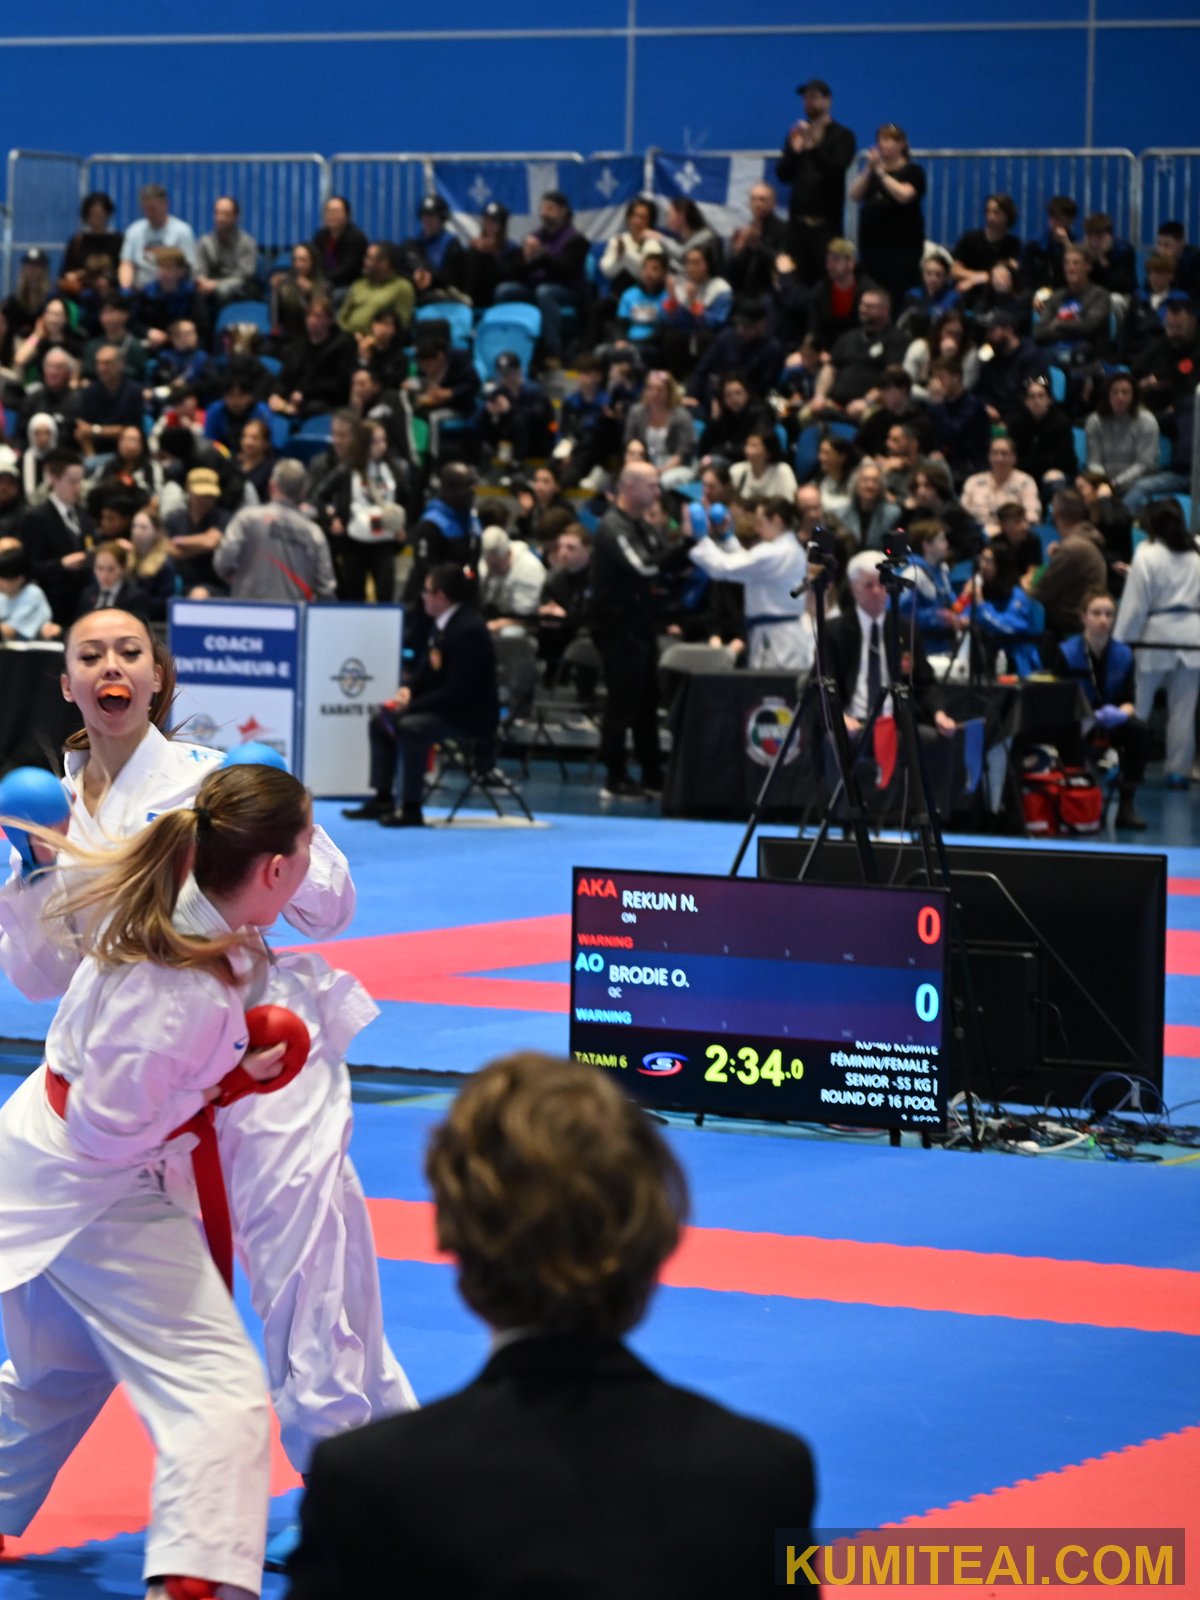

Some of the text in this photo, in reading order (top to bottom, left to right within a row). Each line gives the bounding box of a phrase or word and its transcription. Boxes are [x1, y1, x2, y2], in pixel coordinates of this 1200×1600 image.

[203, 634, 264, 653] COACH
[577, 878, 618, 898] AKA
[622, 890, 699, 913] REKUN N.
[917, 906, 942, 945] 0
[577, 933, 634, 949] WARNING
[575, 952, 605, 973] AO
[608, 964, 690, 988] BRODIE O.
[914, 983, 940, 1023] 0
[575, 1007, 632, 1024] WARNING
[574, 1051, 628, 1069] TATAMI 6
[704, 1044, 804, 1087] 2:34.0
[830, 1050, 930, 1073] FÉMININ/FEMALE
[845, 1072, 890, 1089] SENIOR
[913, 1077, 932, 1092] KG
[820, 1088, 938, 1112] ROUND OF 16 POOL
